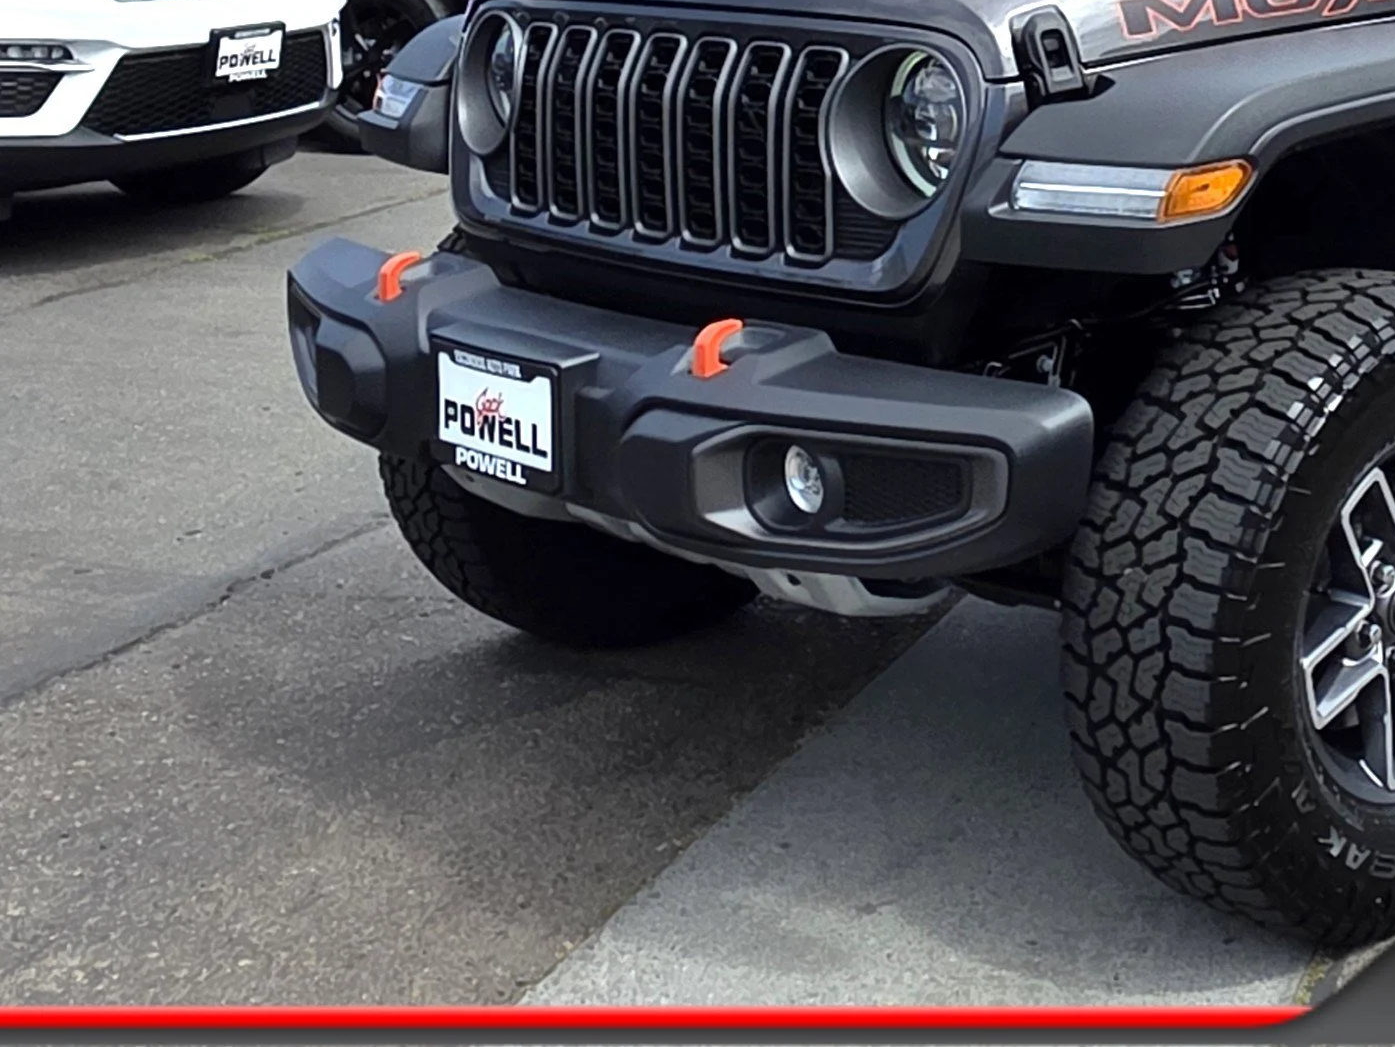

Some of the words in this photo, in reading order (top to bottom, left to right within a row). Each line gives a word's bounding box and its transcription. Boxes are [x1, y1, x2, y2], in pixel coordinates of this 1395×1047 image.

[219, 49, 276, 69] POWELL
[444, 398, 548, 458] POWELL
[456, 447, 527, 485] POWELL
